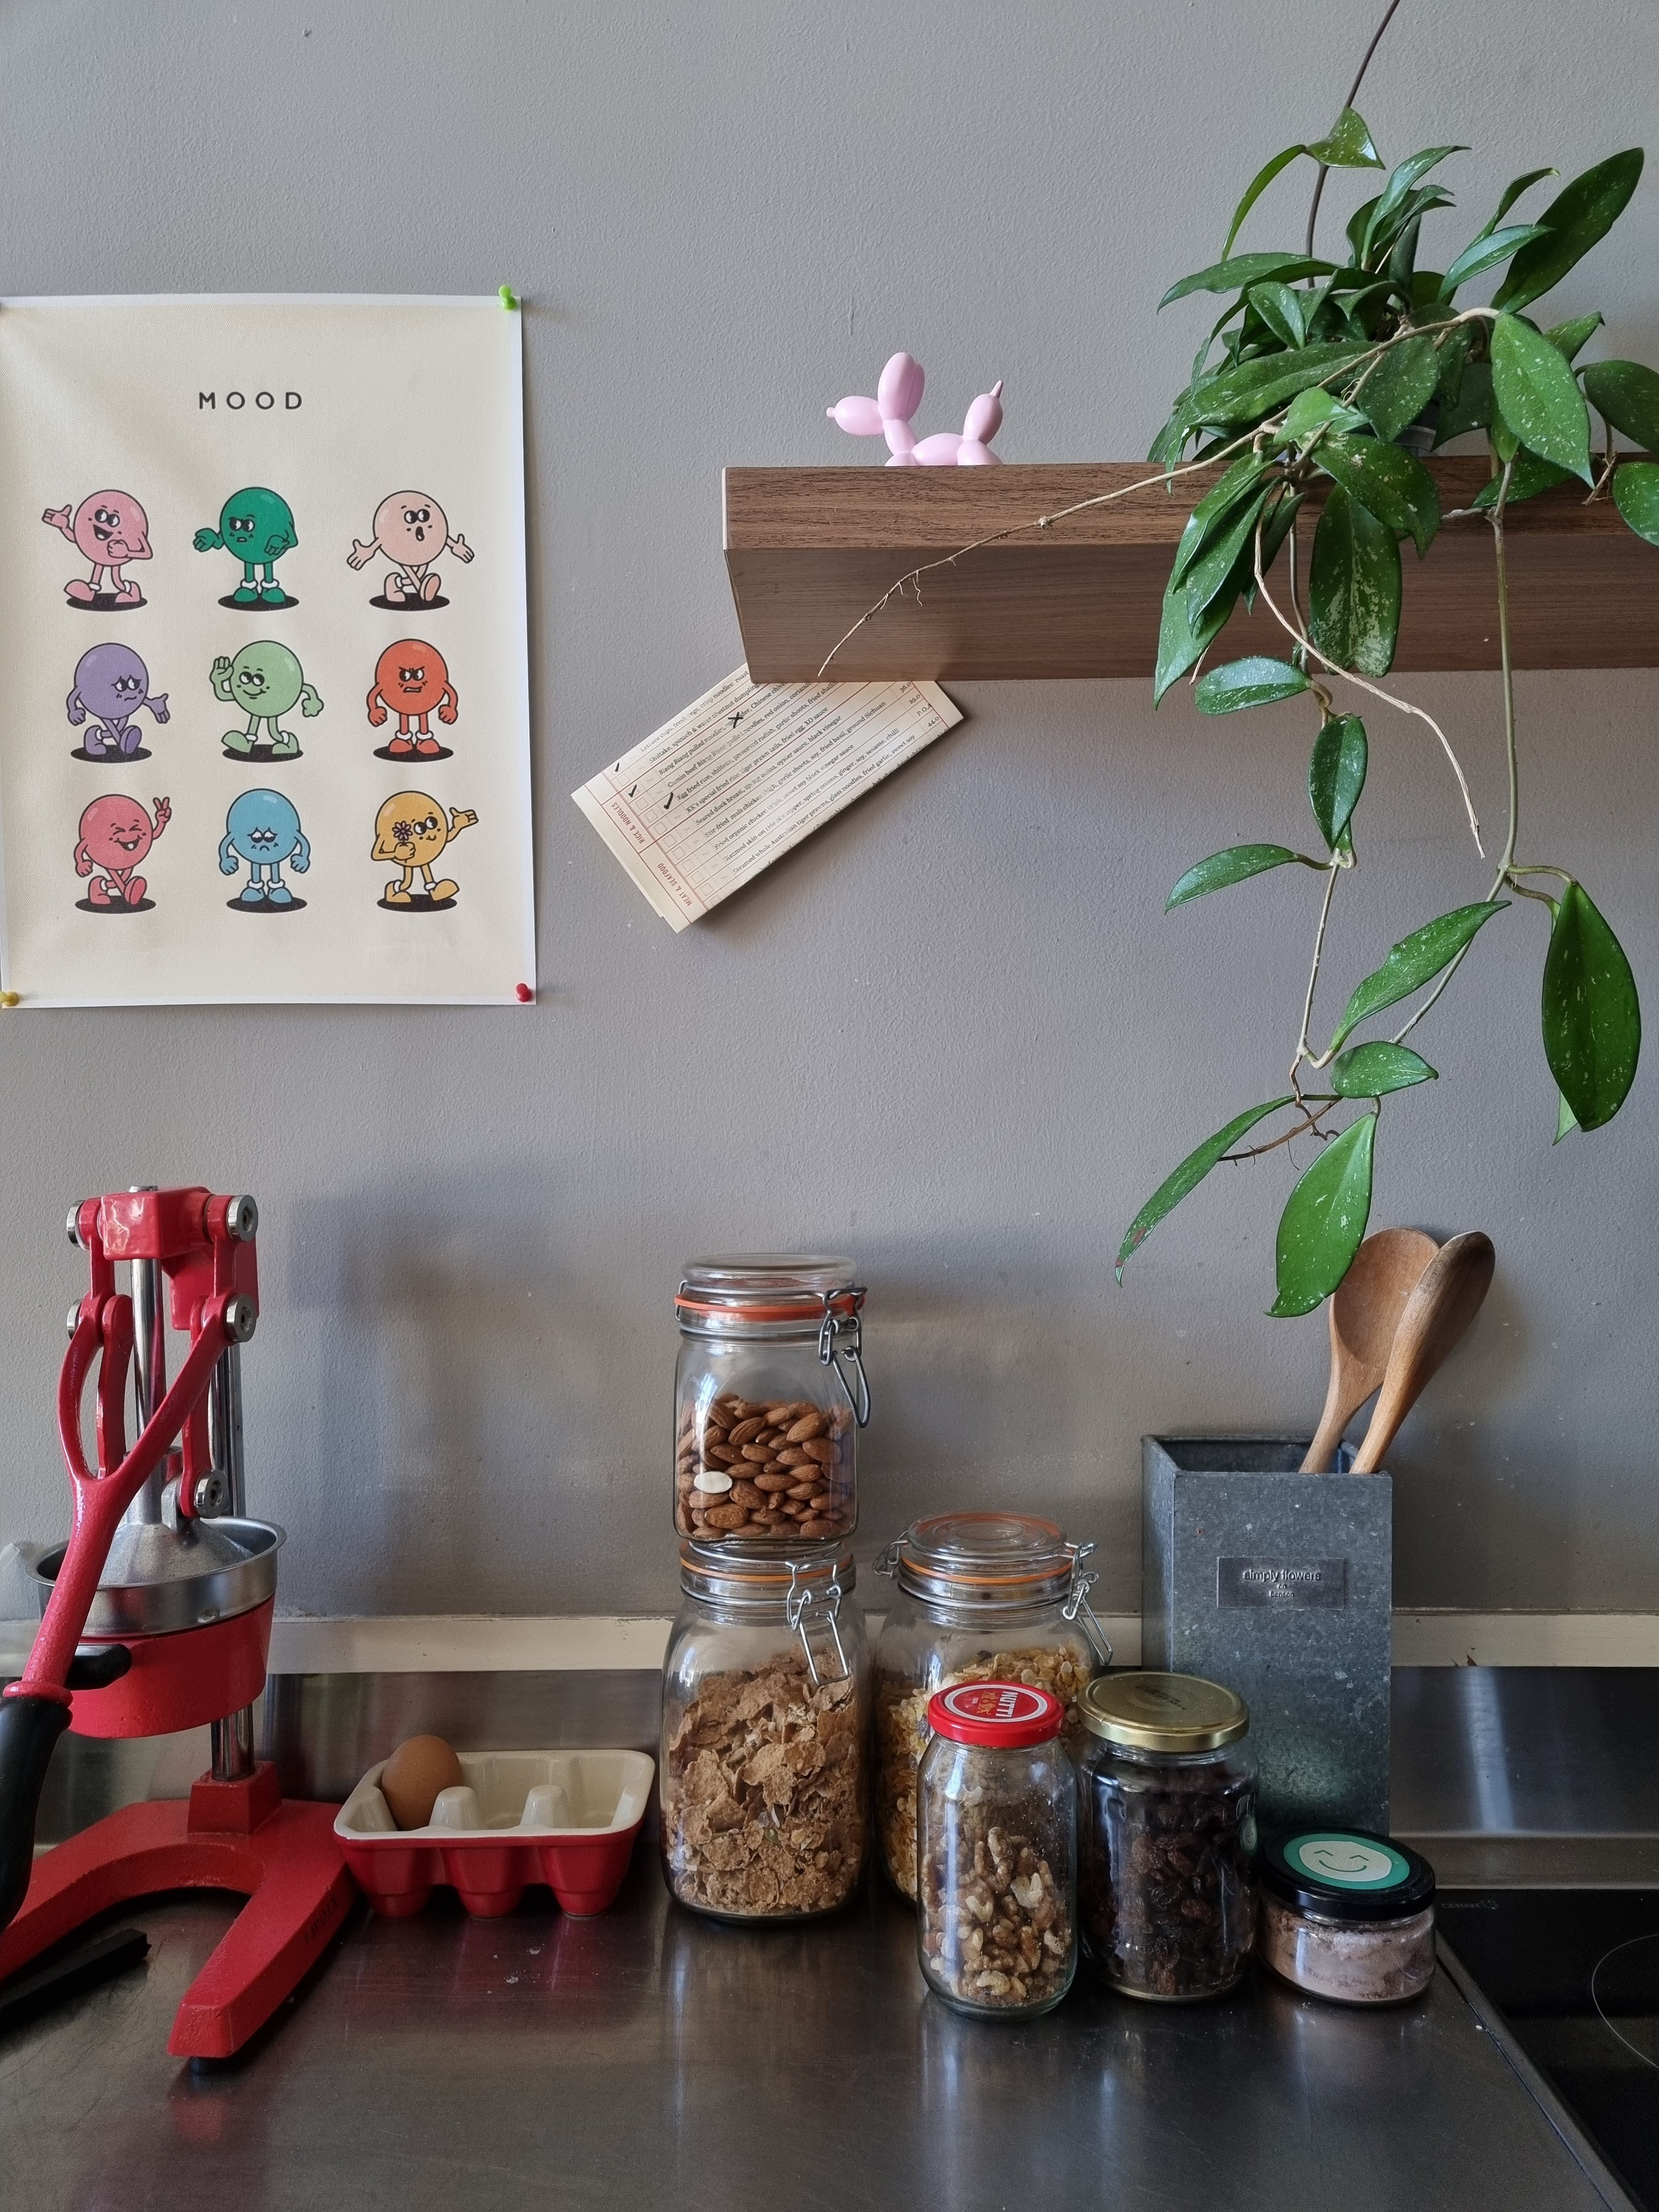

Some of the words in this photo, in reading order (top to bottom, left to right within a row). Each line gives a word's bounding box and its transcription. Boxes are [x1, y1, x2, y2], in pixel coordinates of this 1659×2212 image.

[199, 392, 302, 410] MOOD
[640, 736, 659, 752] Lettuce
[673, 716, 687, 727] fresh
[699, 697, 713, 708] crisp
[713, 682, 734, 698] noodles:
[735, 670, 748, 682] roast
[899, 681, 911, 693] 36.0
[909, 694, 920, 704] 29.0
[648, 746, 673, 763] Shiitake,
[672, 731, 692, 747] spinach
[696, 716, 712, 729] water
[712, 701, 734, 718] chestnut
[658, 762, 674, 775] Biang
[673, 752, 689, 765] Biang
[688, 740, 705, 755] pulled
[751, 692, 771, 708] Chinese
[667, 774, 686, 787] Cumin
[684, 763, 697, 775] beef
[743, 718, 765, 733] noodles,
[764, 709, 774, 718] red
[773, 699, 790, 712] onion,
[676, 791, 689, 800] Egg
[686, 781, 700, 793] fried
[699, 775, 713, 784] rice,
[733, 739, 758, 761] preserved
[758, 728, 776, 742] radish,
[775, 716, 791, 730] garlic
[790, 703, 809, 718] shoots,
[807, 692, 821, 704] fried
[928, 716, 939, 726] 44.0
[695, 809, 714, 825] Seared
[713, 800, 727, 812] duck
[725, 788, 745, 803] breast,
[760, 765, 777, 777] onion,
[777, 752, 793, 765] oyster
[792, 742, 809, 754] sauce,
[807, 730, 823, 742] black
[822, 715, 841, 731] vinegar
[698, 788, 717, 804] special
[715, 779, 729, 791] fried
[753, 751, 770, 766] prawn
[769, 742, 783, 752] tails,
[781, 731, 795, 743] fried
[794, 725, 805, 733] egg,
[803, 717, 813, 726] XO
[813, 707, 828, 720] sauce
[704, 817, 729, 837] Stir-fried
[730, 808, 743, 820] mala
[743, 794, 763, 810] chicken
[777, 771, 793, 785] garlic
[792, 759, 811, 774] shoots,
[810, 751, 821, 760] soy,
[819, 740, 833, 752] fried
[832, 731, 848, 742] basil,
[846, 715, 865, 733] ground
[864, 702, 885, 718] Sichuan
[611, 802, 631, 825] NOODLES
[723, 843, 746, 862] Steamed
[746, 830, 765, 845] skin-on
[803, 788, 821, 802] spring
[820, 775, 839, 789] onions,
[838, 761, 856, 776] ginger,
[855, 754, 867, 762] soy,
[866, 740, 887, 755] sesame,
[885, 727, 899, 740] chilli
[729, 823, 748, 839] organic
[797, 780, 806, 789] soy
[805, 769, 820, 781] black
[820, 755, 839, 770] vinegar
[839, 744, 854, 757] sauce
[732, 854, 755, 874] Steamed
[754, 844, 771, 856] whole
[771, 824, 797, 845] Australian
[796, 814, 809, 825] tiger
[809, 800, 830, 816] prawns,
[829, 789, 842, 802] glass
[842, 775, 864, 791] noodles,
[862, 764, 876, 775] fried
[875, 753, 892, 767] garlic,
[890, 741, 906, 754] sweet
[906, 734, 917, 743] soy
[633, 830, 645, 843] RICE
[657, 863, 677, 886] SEAFOOD
[679, 891, 692, 906] MEAT
[1243, 1569, 1279, 1583] simply
[1281, 1570, 1322, 1581] flowers
[995, 1691, 1018, 1717] MUTTI
